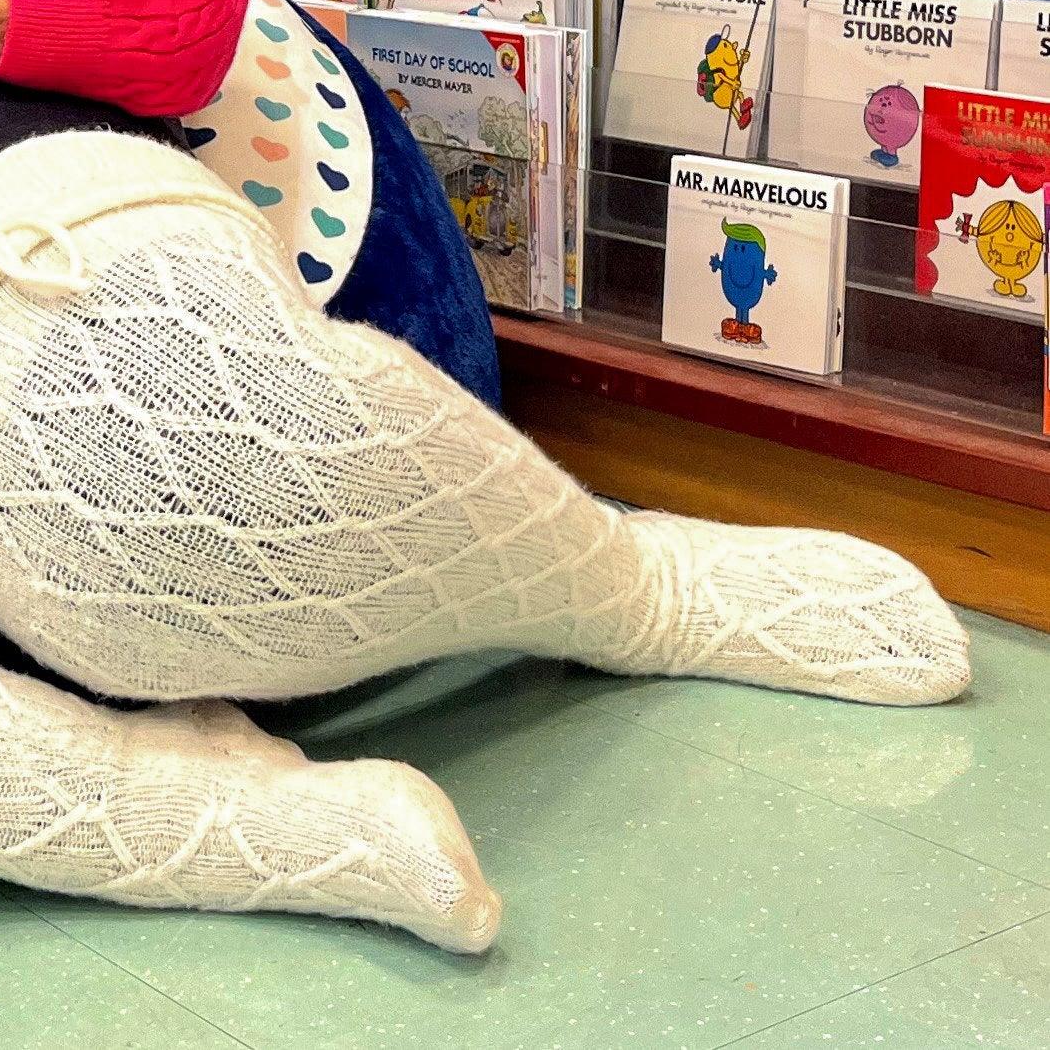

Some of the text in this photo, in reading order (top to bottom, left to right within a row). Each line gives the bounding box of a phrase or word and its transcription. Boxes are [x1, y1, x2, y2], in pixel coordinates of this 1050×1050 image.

[907, 3, 958, 25] MISS
[843, 21, 953, 48] STUBBORN
[372, 48, 495, 78] FIRST DAY OF SCHOOL
[398, 73, 473, 94] BY MERCER MAYER
[958, 101, 1015, 127] LITTLE
[675, 170, 827, 210] MR. MARVELOUS
